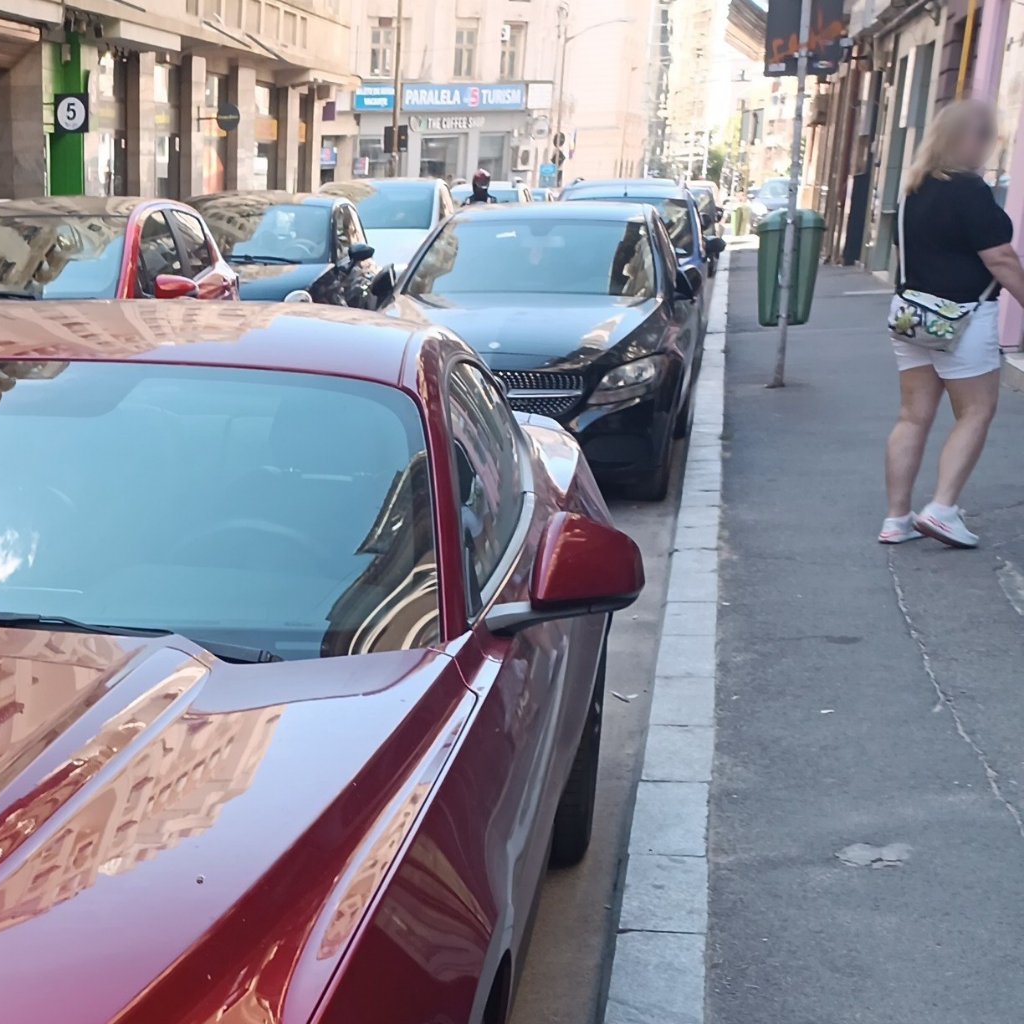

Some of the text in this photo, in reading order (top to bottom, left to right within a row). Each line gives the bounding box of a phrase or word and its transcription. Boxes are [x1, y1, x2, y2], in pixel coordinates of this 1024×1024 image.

[405, 89, 461, 105] PARALELA
[481, 88, 522, 104] TURISM
[66, 102, 77, 121] 5
[428, 116, 441, 129] THE
[442, 116, 468, 129] COFFEE
